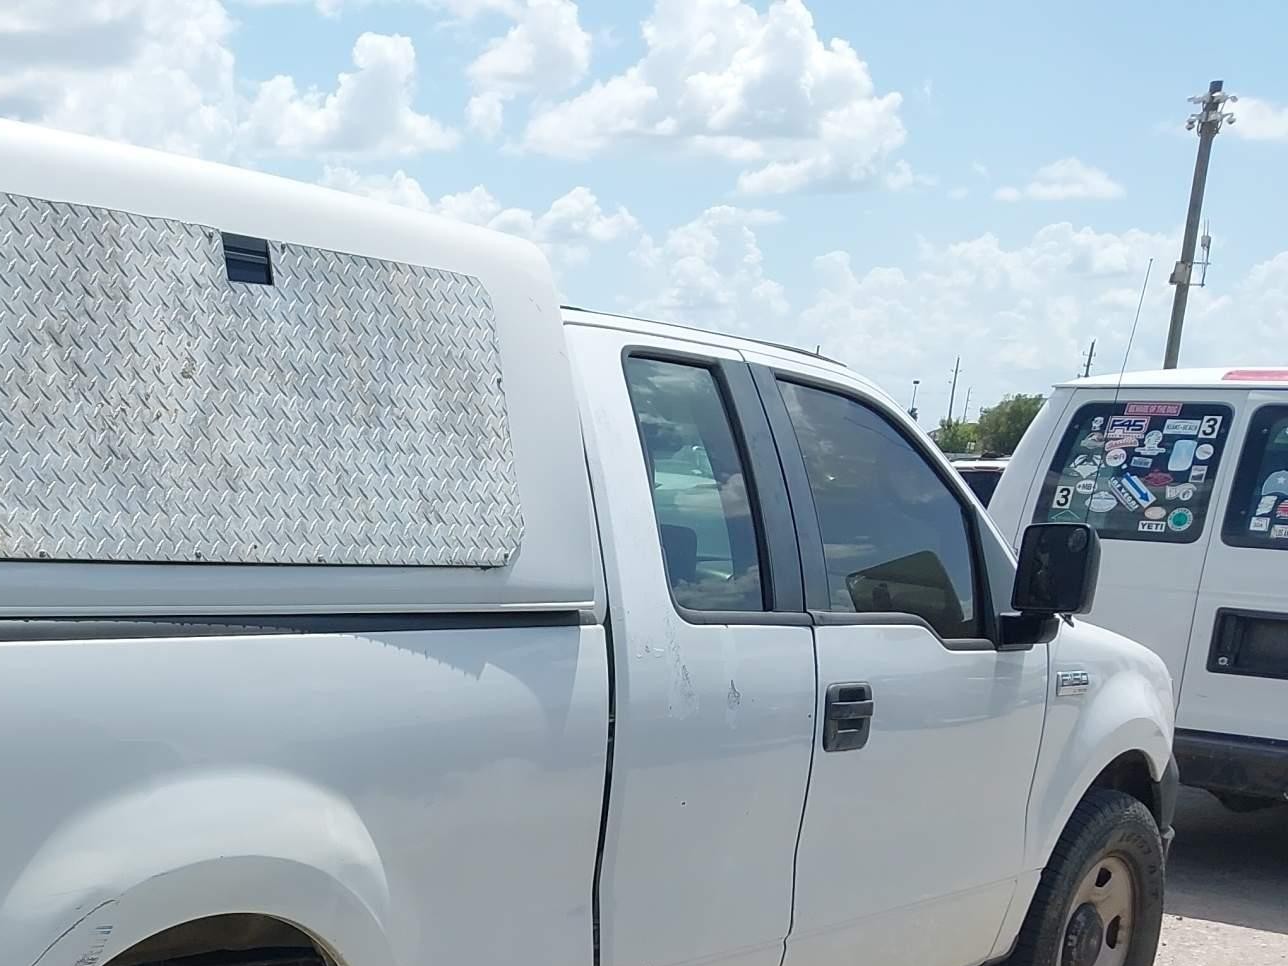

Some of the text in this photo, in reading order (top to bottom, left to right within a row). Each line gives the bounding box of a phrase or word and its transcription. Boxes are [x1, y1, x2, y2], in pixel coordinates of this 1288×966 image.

[1110, 419, 1146, 432] F45
[1202, 417, 1218, 436] 3
[1056, 488, 1070, 507] 3
[1140, 522, 1164, 530] YETI
